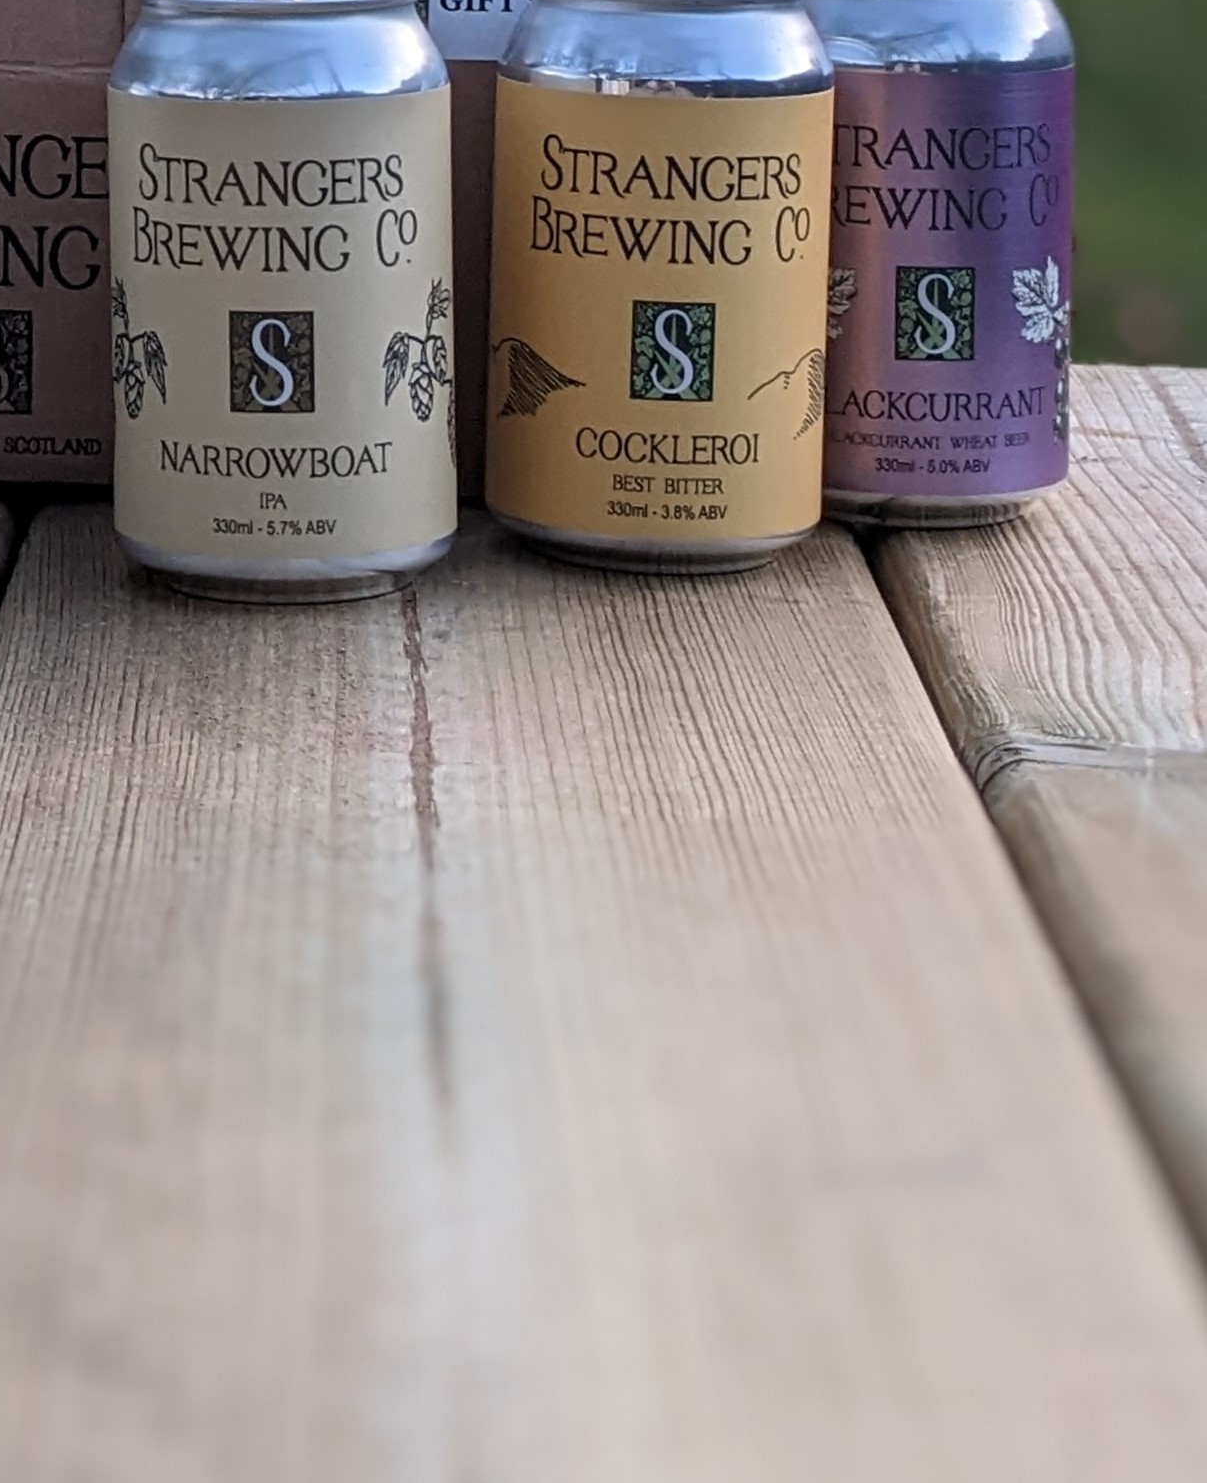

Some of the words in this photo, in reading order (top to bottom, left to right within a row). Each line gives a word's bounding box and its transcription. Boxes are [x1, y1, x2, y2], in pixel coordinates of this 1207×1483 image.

[833, 123, 1051, 170] TRANGERS
[139, 143, 404, 207] STRANGERS
[541, 133, 801, 201] STRANGERS
[133, 206, 350, 272] BREWING
[530, 195, 752, 266] BREWING
[825, 386, 1046, 422] LACKCURRANT
[3, 436, 103, 455] SCOTLAND
[159, 439, 392, 478] NARROWBOAT
[575, 427, 759, 465] COCKLEROI
[950, 435, 998, 449] WHEAT
[963, 458, 991, 473] ABV
[259, 492, 287, 510] IPA
[612, 474, 654, 493] BEST
[664, 477, 724, 494] BITTER
[212, 517, 253, 535] 330ml
[266, 520, 303, 536] 5.7%
[305, 519, 337, 535] ABV
[606, 501, 648, 518] 330ml
[661, 504, 696, 520] 3.8%
[698, 504, 727, 520] ABV
